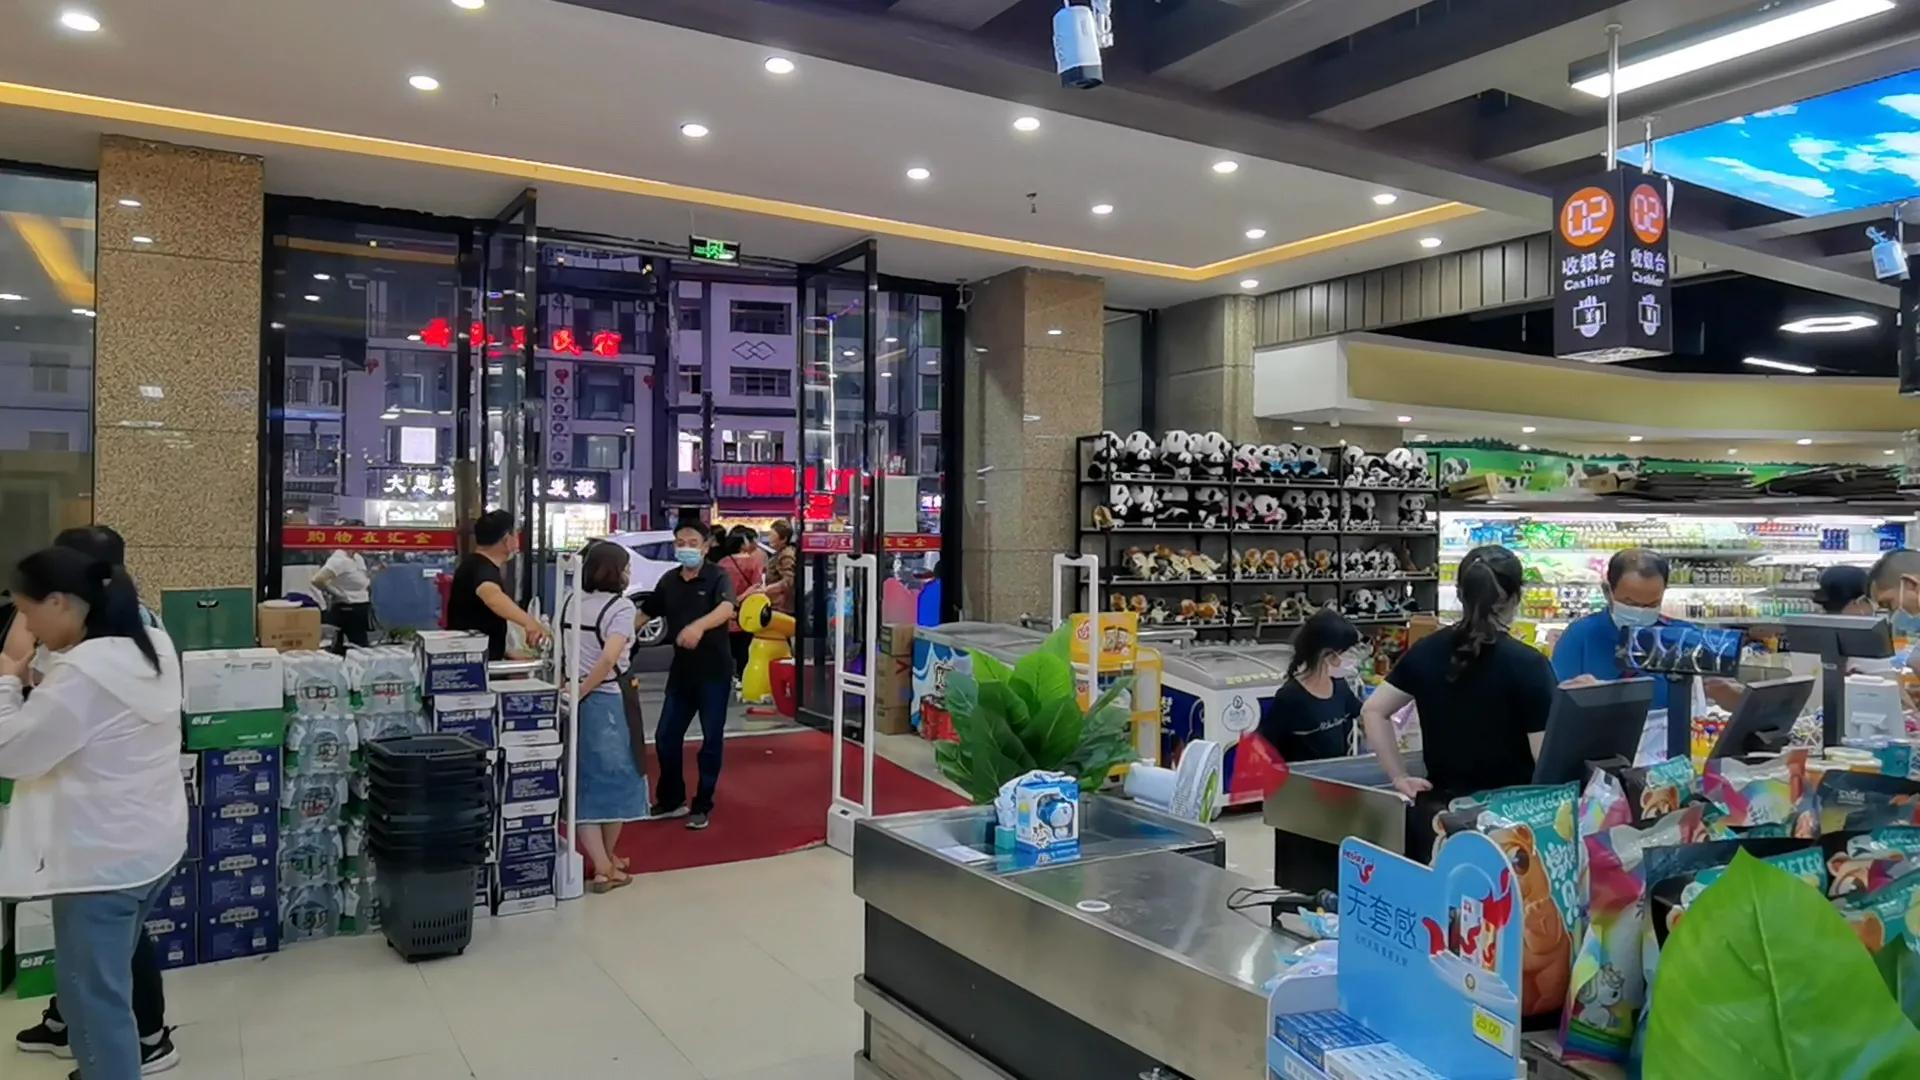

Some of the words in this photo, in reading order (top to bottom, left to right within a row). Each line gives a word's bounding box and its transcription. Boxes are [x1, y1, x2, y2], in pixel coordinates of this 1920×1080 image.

[1568, 196, 1608, 237] 02
[1636, 194, 1659, 233] 02
[1562, 250, 1616, 275] 收银台
[1632, 249, 1666, 272] 收银台
[1564, 274, 1613, 290] Cashier
[1347, 884, 1417, 949] 无套感
